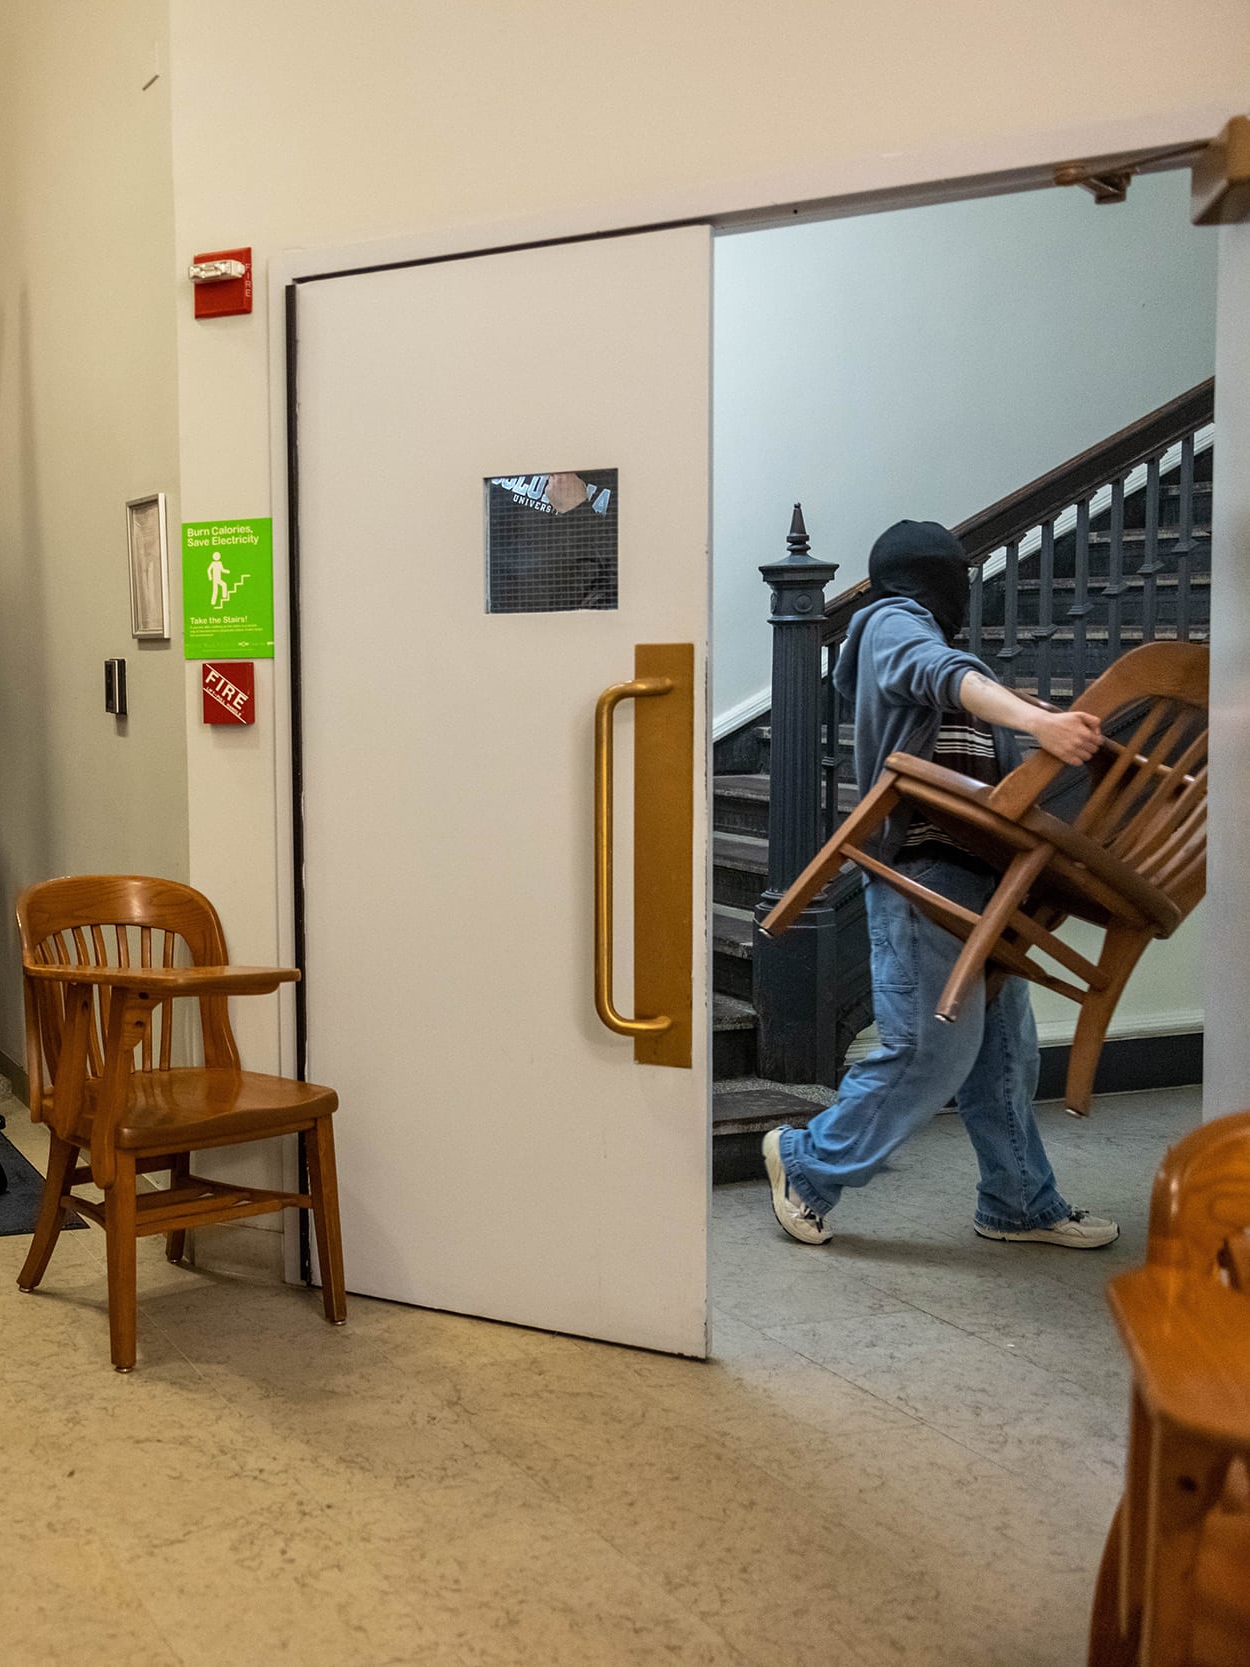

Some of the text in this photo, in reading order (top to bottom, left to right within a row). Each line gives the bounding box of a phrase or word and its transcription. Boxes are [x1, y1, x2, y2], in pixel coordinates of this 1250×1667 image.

[513, 494, 559, 516] UNIVERS
[187, 528, 210, 537] Burn
[187, 534, 259, 547] Save Electricity
[190, 615, 248, 625] Take the Stairs!
[205, 670, 248, 710] FIRE
